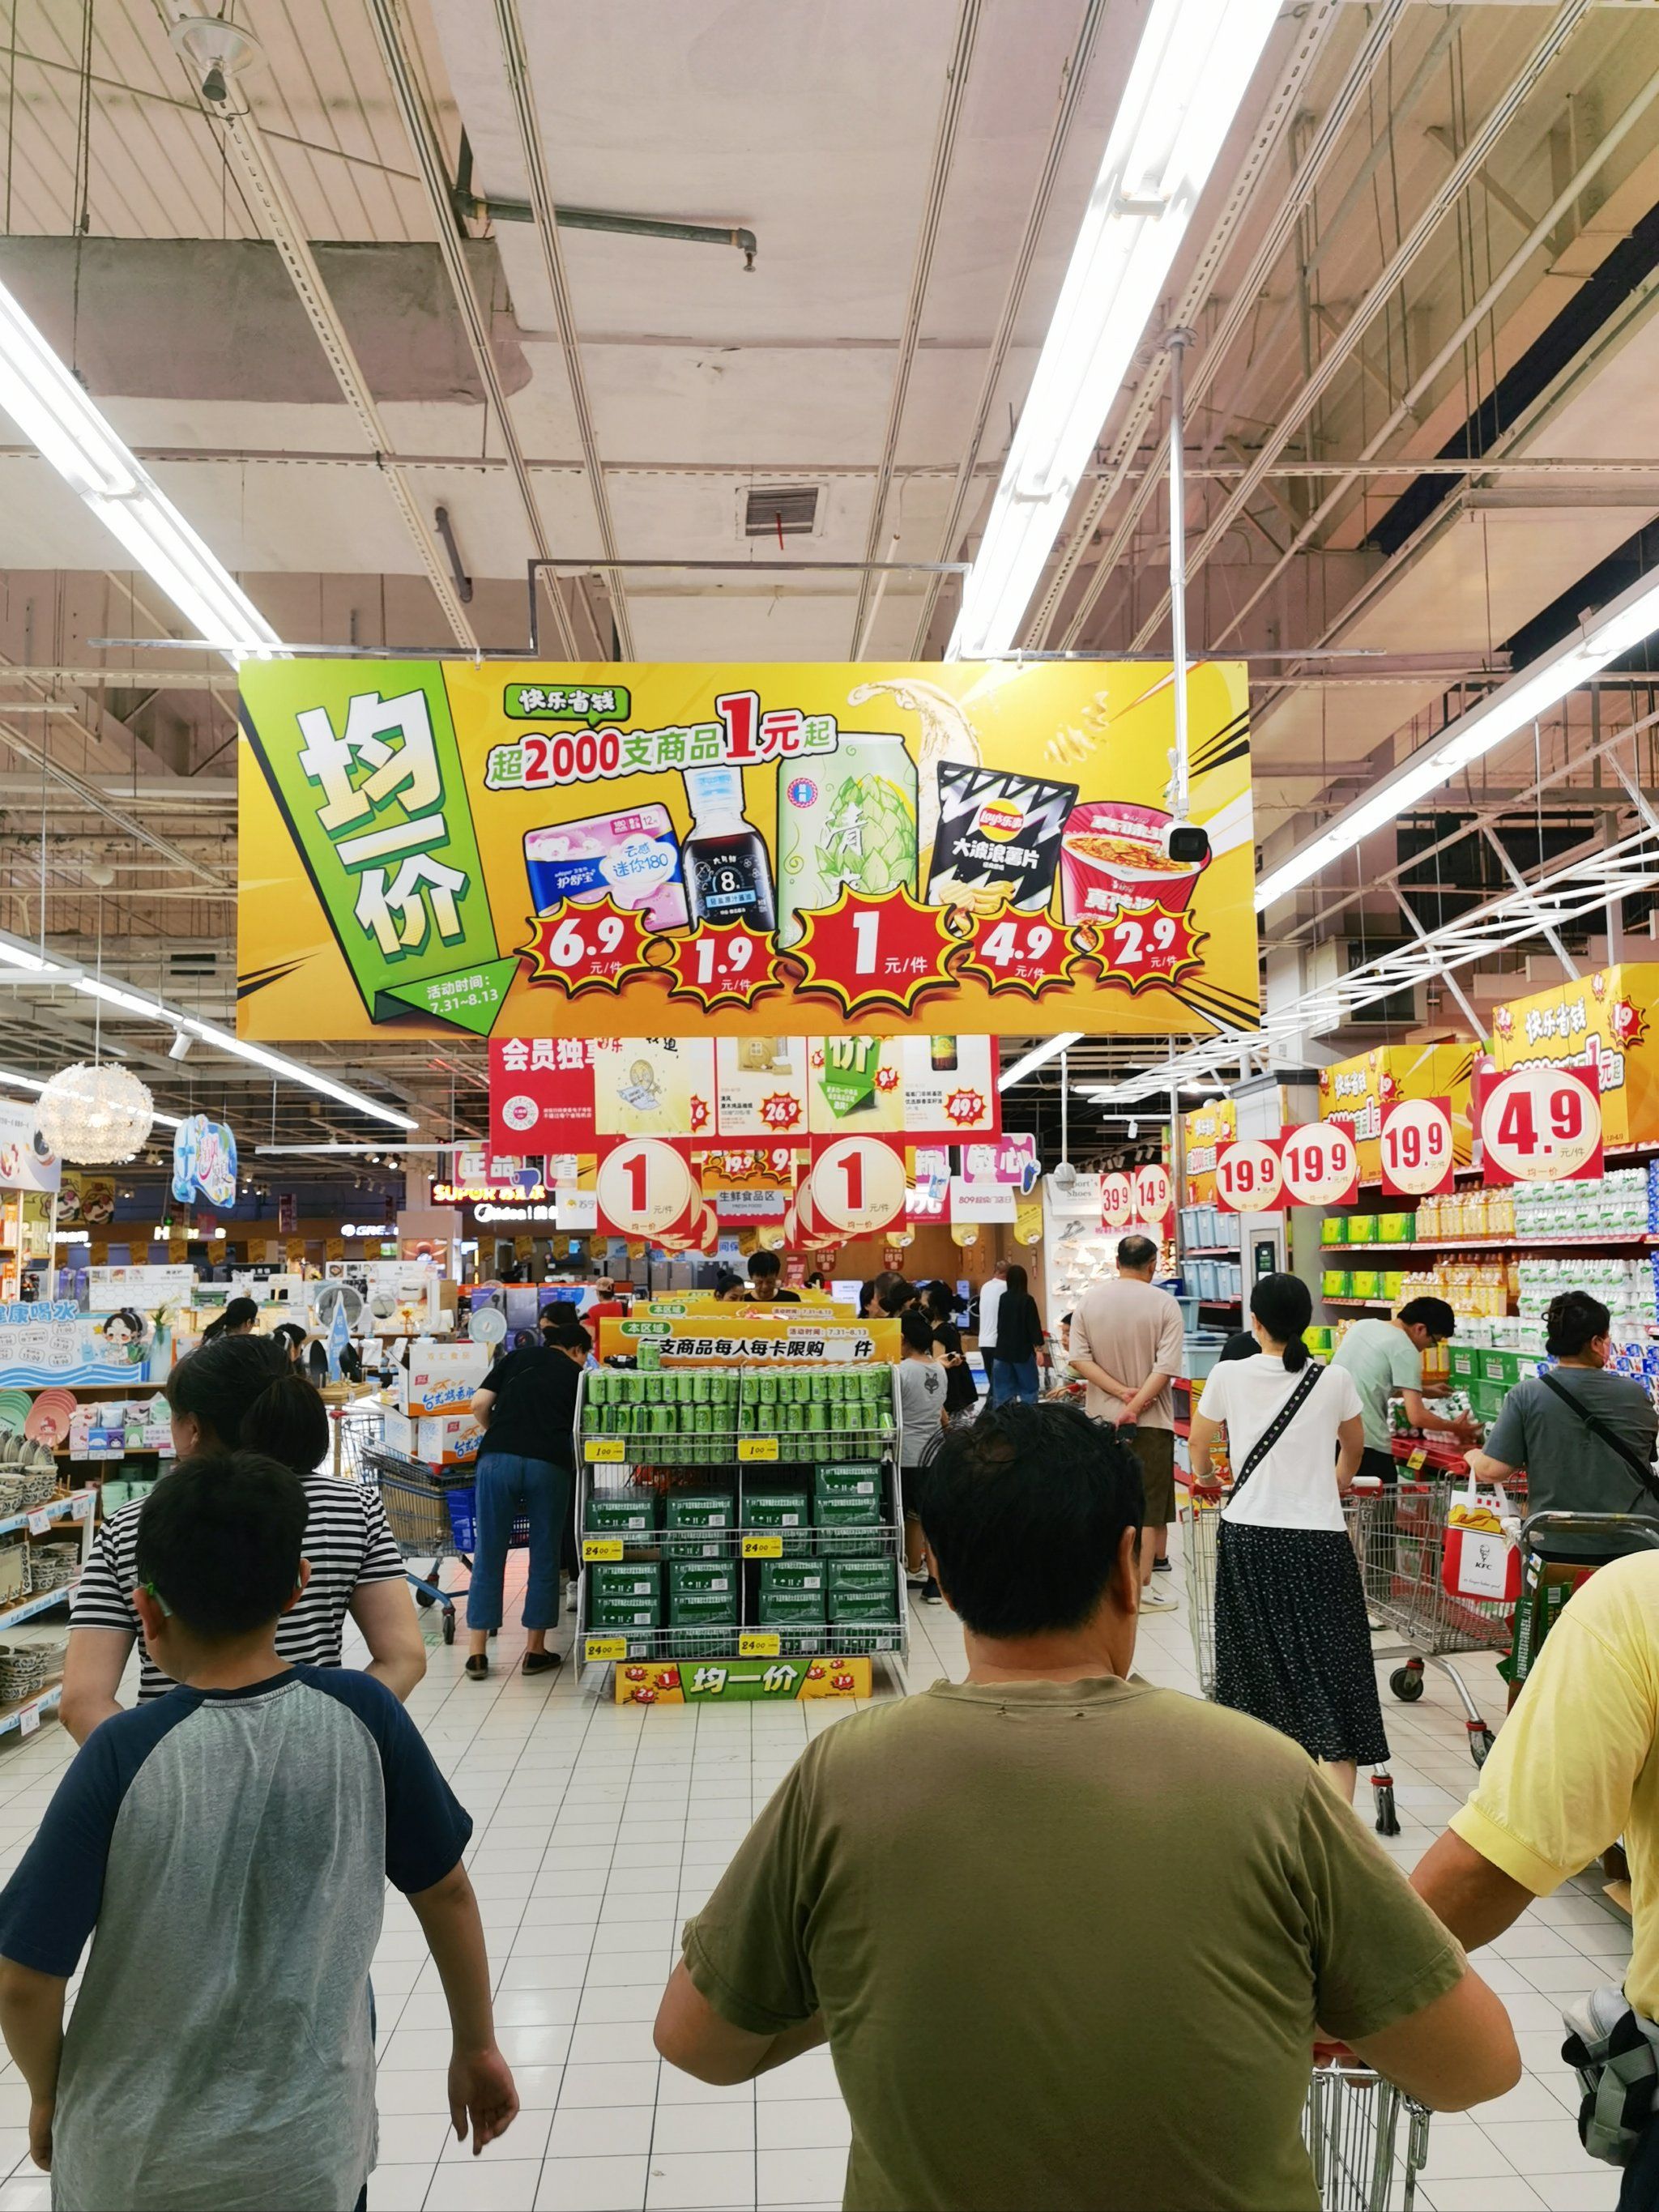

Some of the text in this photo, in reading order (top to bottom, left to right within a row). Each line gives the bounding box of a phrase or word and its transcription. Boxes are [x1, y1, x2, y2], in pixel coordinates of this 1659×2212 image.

[518, 687, 616, 714] 快乐省钱
[296, 688, 467, 955] 均一价
[625, 842, 650, 857] 云感
[952, 837, 1040, 869] 大波浪薯片
[612, 853, 669, 878] 迷你180
[557, 872, 594, 889] 护舒宝
[549, 916, 625, 967] 6.9
[852, 910, 880, 974] 1
[980, 922, 1053, 966] 4.9
[1114, 918, 1176, 965] 2.9
[590, 961, 623, 974] 元/件
[695, 936, 753, 984] 1.9
[885, 956, 928, 974] 元/件
[1150, 955, 1177, 969] 元/件
[1015, 964, 1045, 979] 元/件
[721, 978, 752, 991] 元/件
[766, 1102, 797, 1121] 26.9
[949, 1097, 981, 1117] 49.9
[1498, 1089, 1583, 1155] 4.9
[1385, 1122, 1443, 1169] 19.9
[725, 1156, 753, 1173] 19.9
[1286, 1143, 1346, 1183] 19.9
[623, 1153, 646, 1211] 1
[838, 1151, 863, 1209] 1
[1221, 1157, 1274, 1192] 19.9
[433, 1183, 497, 1202] SUPOR
[719, 1191, 775, 1202] 生鲜食品区
[632, 1222, 656, 1231] 均一价
[847, 1221, 872, 1229] 均一价
[628, 1323, 664, 1334] 本区域
[855, 1340, 872, 1357] 件
[690, 1664, 798, 1693] 均一价
